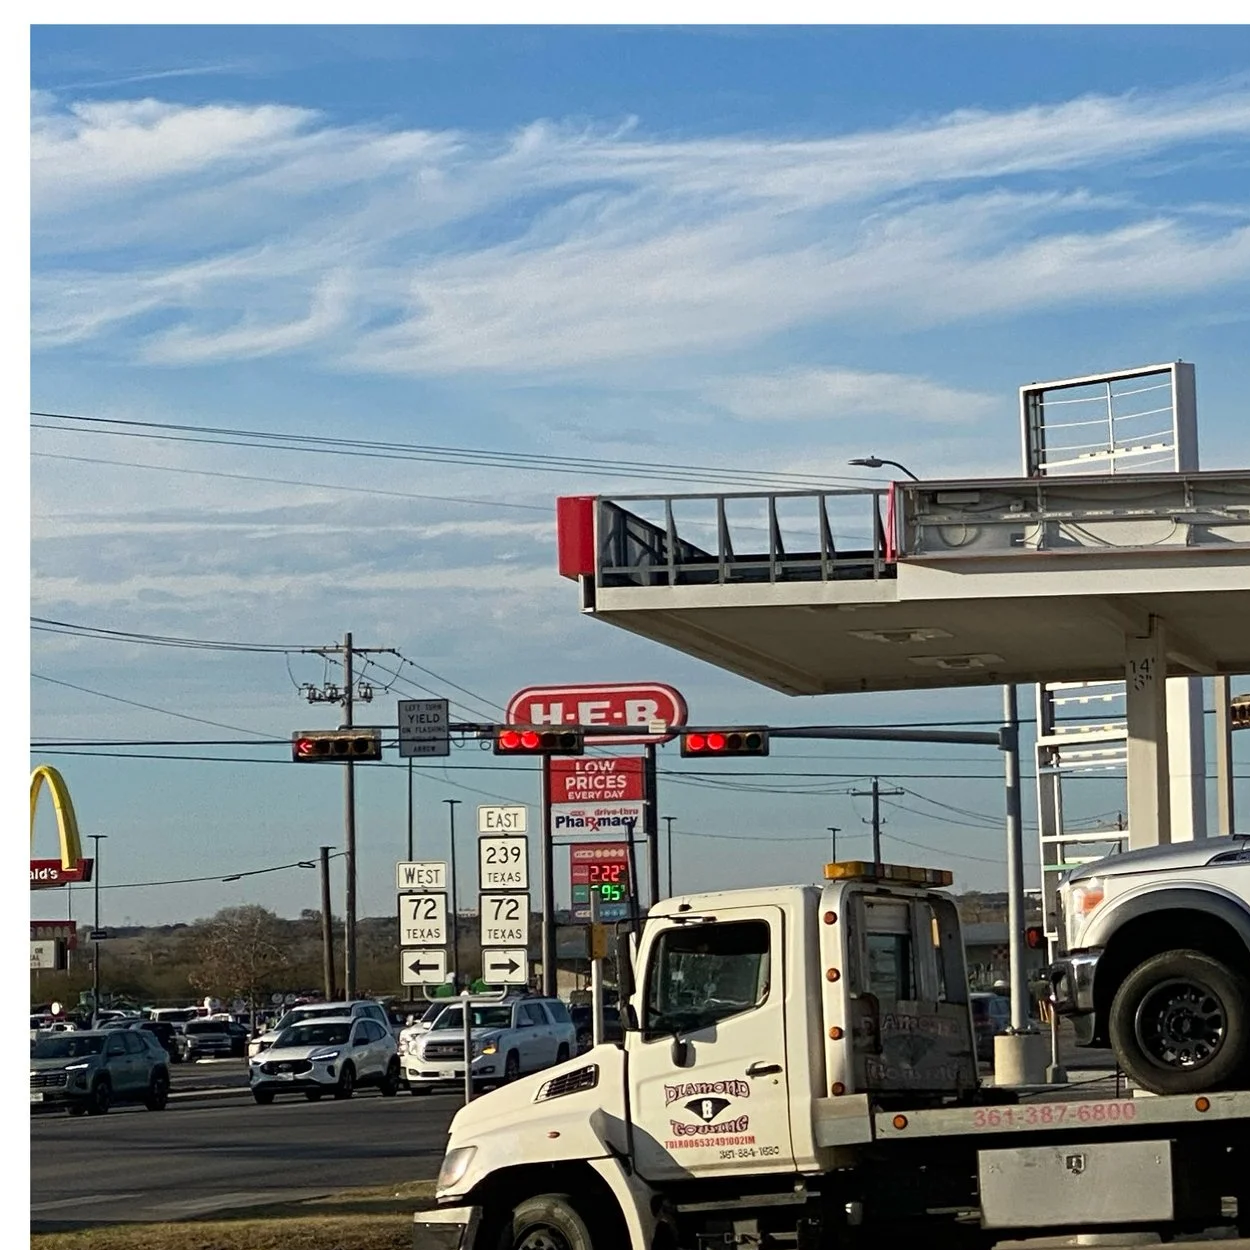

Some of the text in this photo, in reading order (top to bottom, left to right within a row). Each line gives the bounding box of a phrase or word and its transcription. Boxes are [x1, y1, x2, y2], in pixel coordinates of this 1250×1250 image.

[408, 713, 440, 724] YIELD
[575, 761, 616, 775] LOW
[565, 775, 627, 790] PRICES
[568, 790, 625, 800] EVERY DAY
[486, 811, 519, 829] EAST
[594, 808, 639, 817] drive-thru
[486, 846, 521, 864] 239
[30, 867, 58, 880] ald's
[404, 867, 440, 884] WEST
[488, 872, 521, 882] TEXAS
[408, 898, 437, 920] 72
[490, 898, 520, 920] 72
[406, 929, 440, 939] TEXAS
[487, 929, 522, 939] TEXAS
[664, 1079, 750, 1107] DIAMOND
[973, 1102, 1138, 1129] 361-387-6800
[670, 1114, 750, 1137] TOWING
